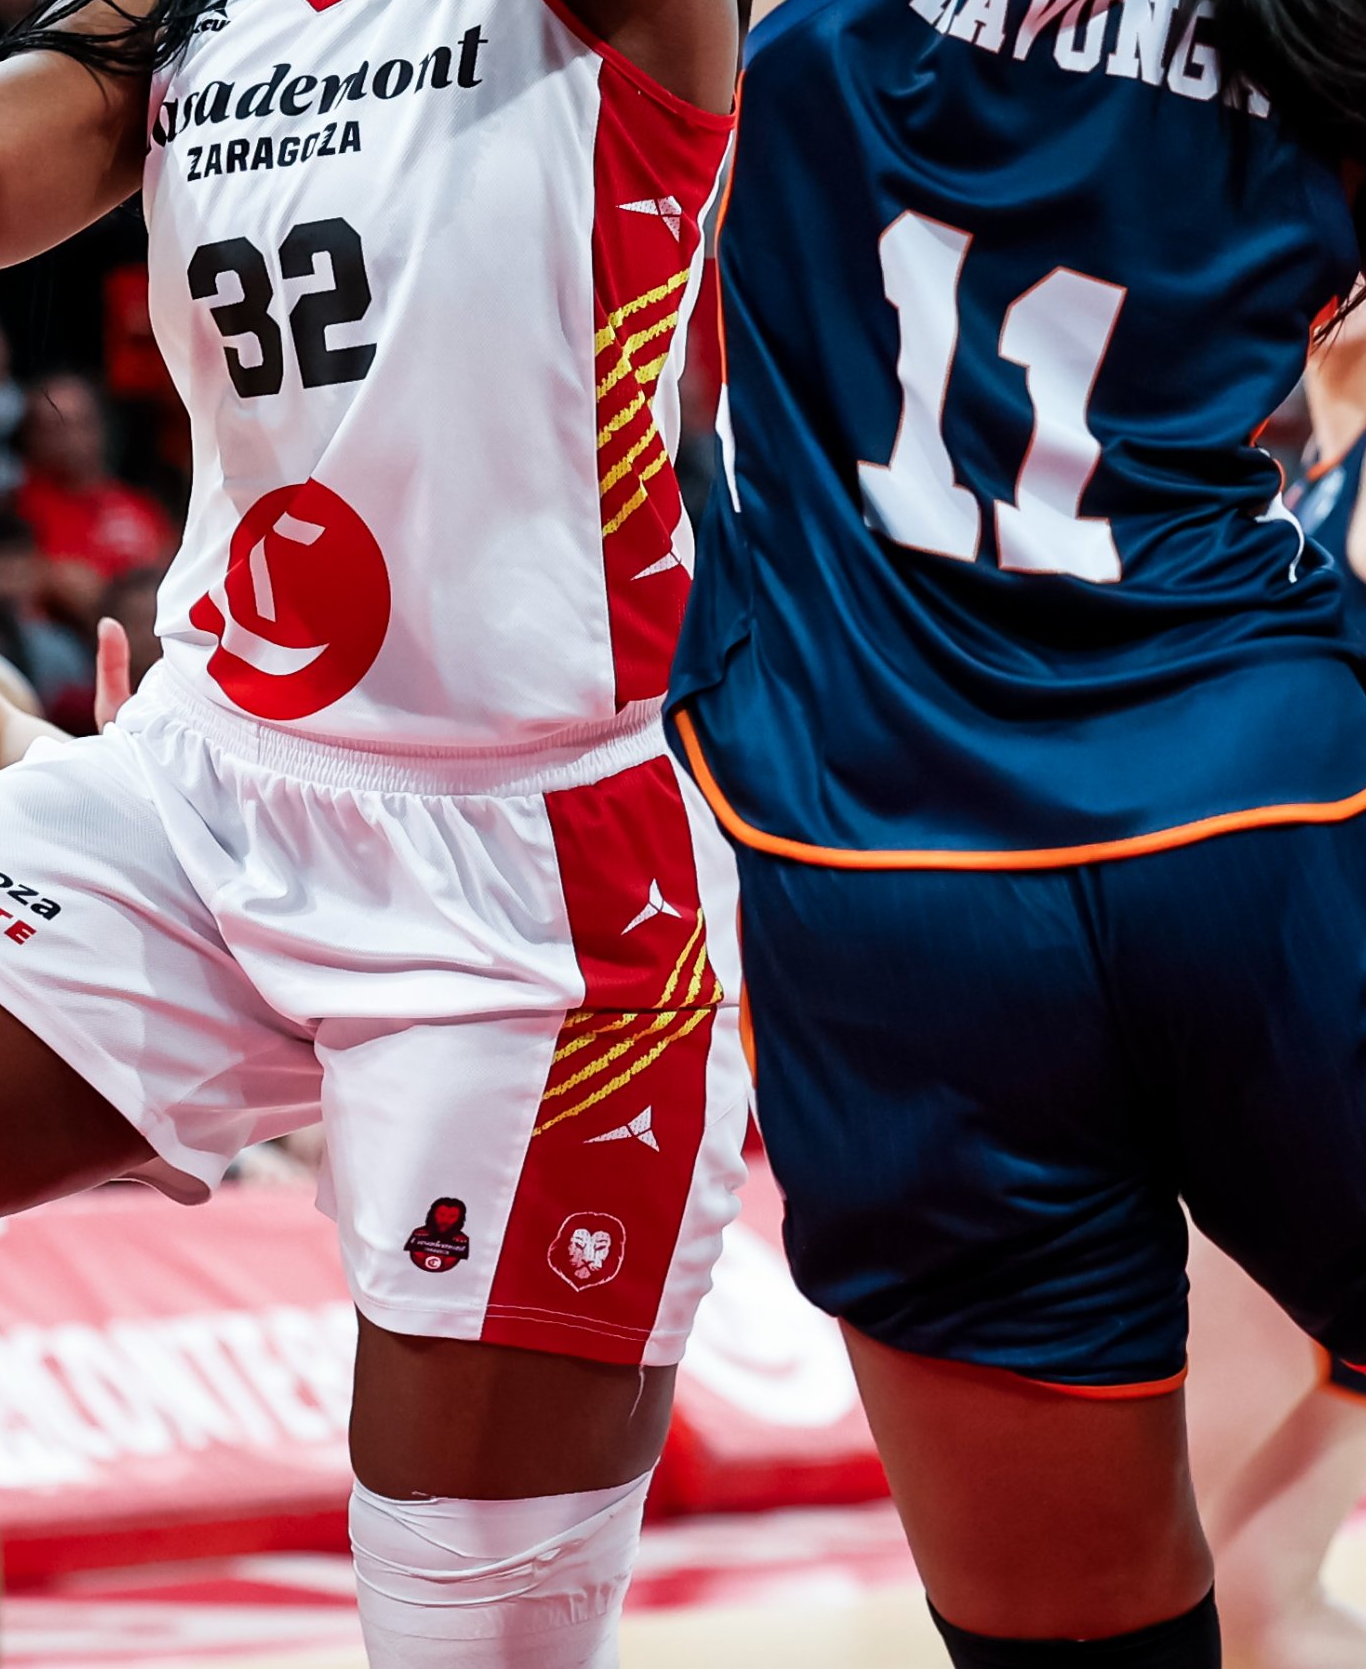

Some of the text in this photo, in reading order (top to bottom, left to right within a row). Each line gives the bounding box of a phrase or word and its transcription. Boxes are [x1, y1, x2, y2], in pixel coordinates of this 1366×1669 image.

[150, 24, 489, 148] asademont
[186, 120, 362, 183] ZARAGOZA
[187, 216, 377, 399] 32
[856, 208, 1127, 584] 11
